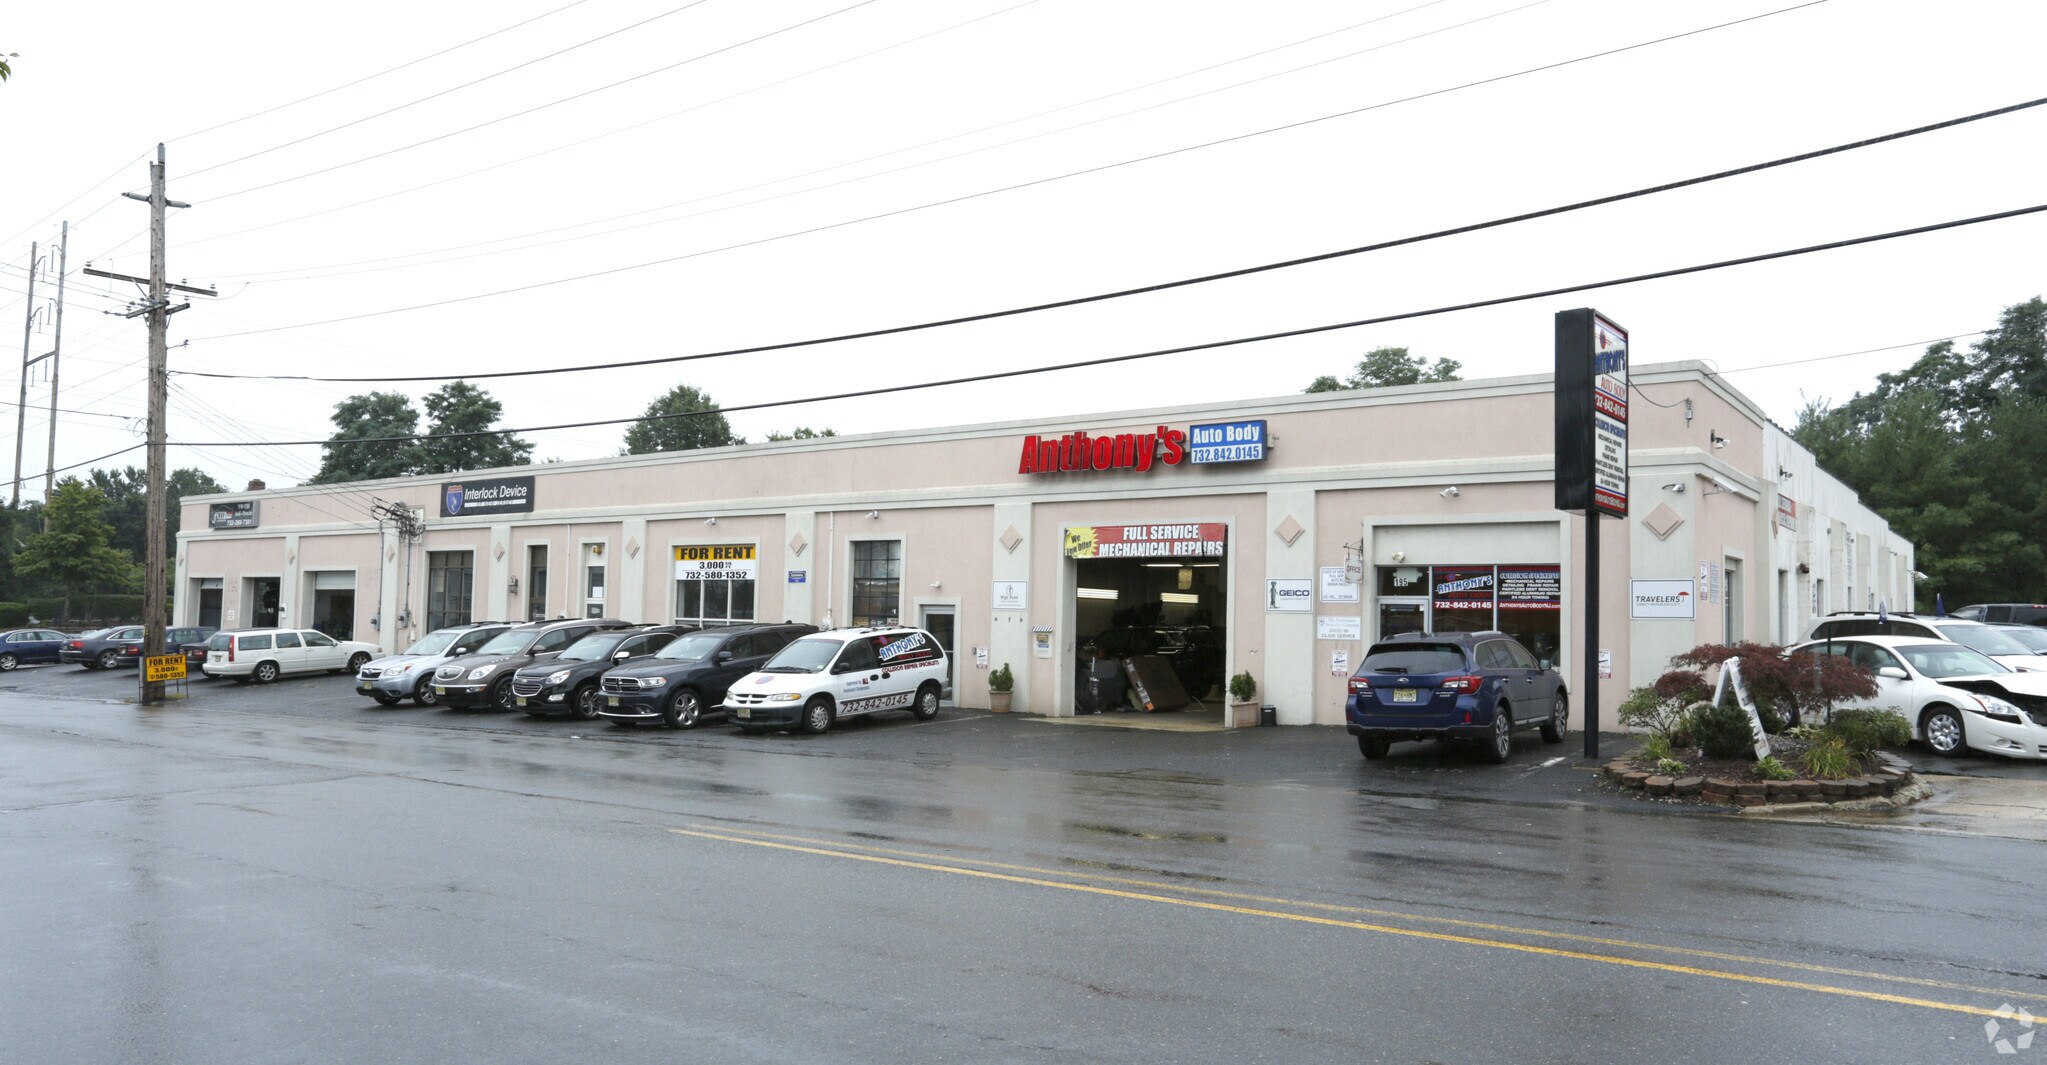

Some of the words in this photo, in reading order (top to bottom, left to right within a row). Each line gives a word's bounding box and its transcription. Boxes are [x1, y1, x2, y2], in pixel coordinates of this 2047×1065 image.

[1193, 428, 1223, 444] Auto
[1226, 424, 1260, 442] Body
[1018, 425, 1186, 475] Anthony's
[1193, 445, 1260, 462] 732.842.0145
[464, 486, 498, 500] Interlock
[499, 485, 528, 498] Device
[1071, 534, 1081, 543] We
[1123, 526, 1148, 541] FULL
[1150, 524, 1199, 540] SERVICE
[680, 547, 709, 560] FOR
[713, 546, 754, 559] RENT
[1100, 542, 1171, 557] MECHANICAL
[1174, 540, 1224, 556] REPAIRS
[699, 561, 724, 569] 3,000
[1346, 565, 1361, 573] OFFICE
[685, 571, 747, 580] 732-580-1352
[1394, 578, 1408, 586] 195
[1437, 574, 1493, 594] ANTHONY'S
[1279, 589, 1310, 597] GEICO
[880, 632, 926, 661] ANTHONY'S
[149, 658, 164, 667] FOR
[165, 656, 184, 665] RENT
[841, 695, 909, 714] 732-842-0145
